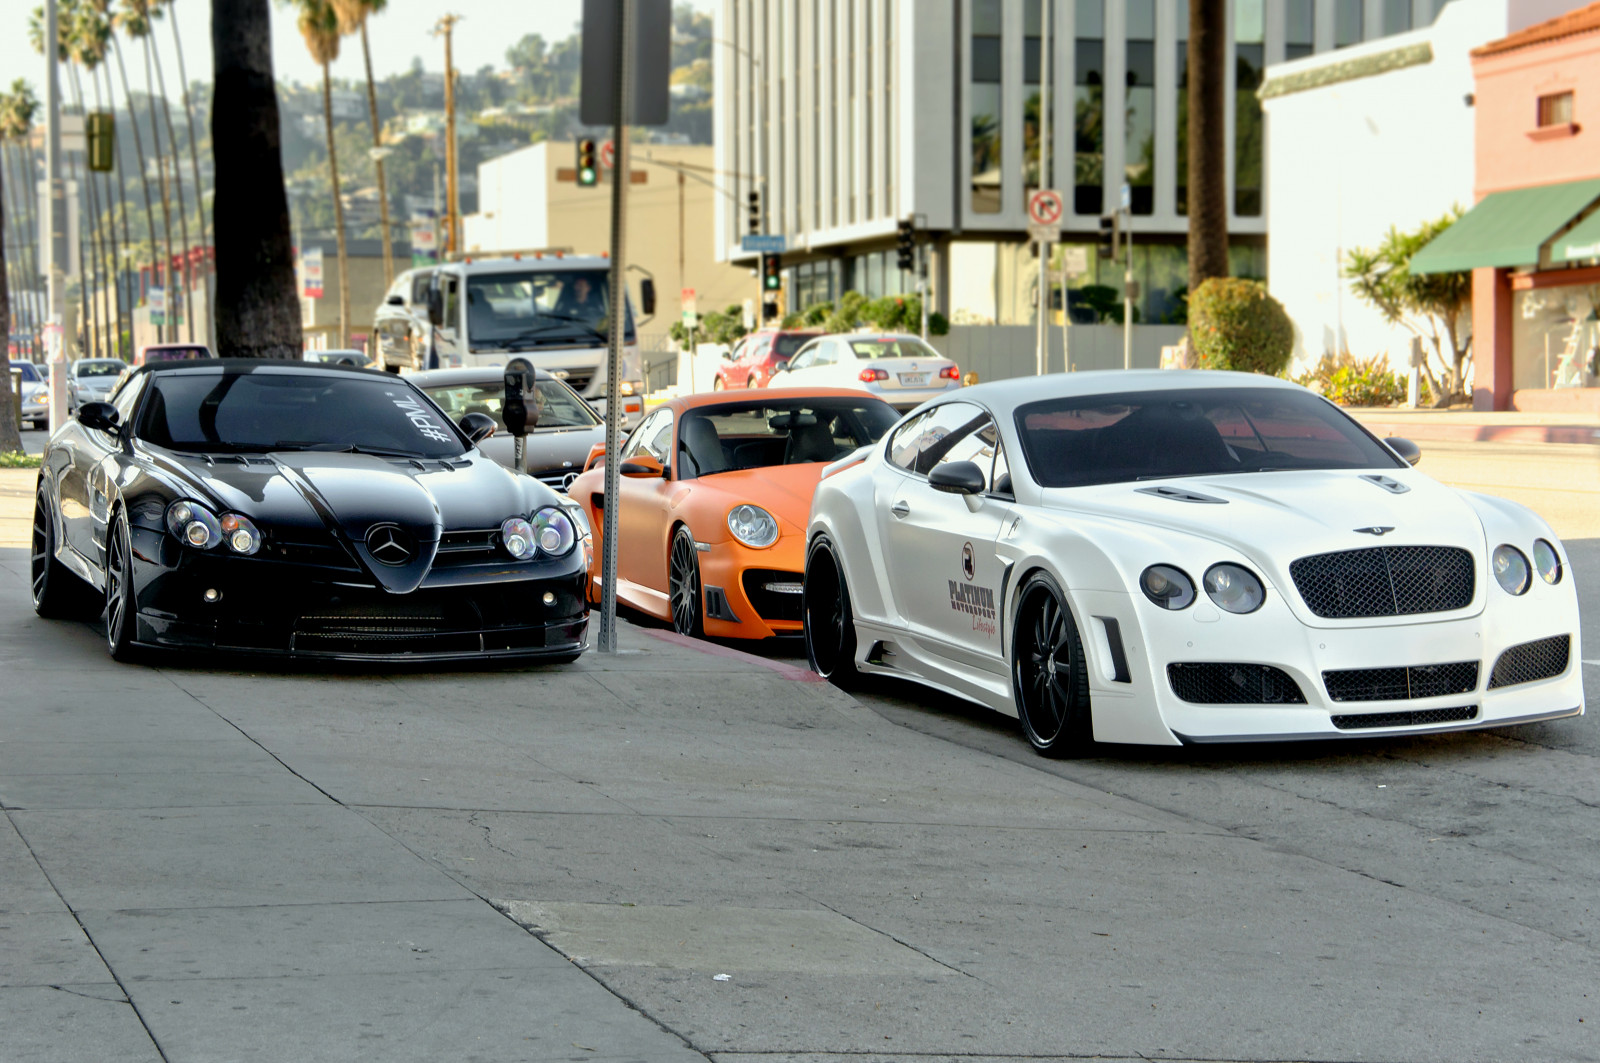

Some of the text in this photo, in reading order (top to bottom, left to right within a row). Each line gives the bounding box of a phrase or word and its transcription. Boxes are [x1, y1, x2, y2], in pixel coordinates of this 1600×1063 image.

[948, 580, 995, 609] PLATINUM
[951, 600, 996, 620] MOTORSPORT
[972, 614, 996, 639] Lifestyle
